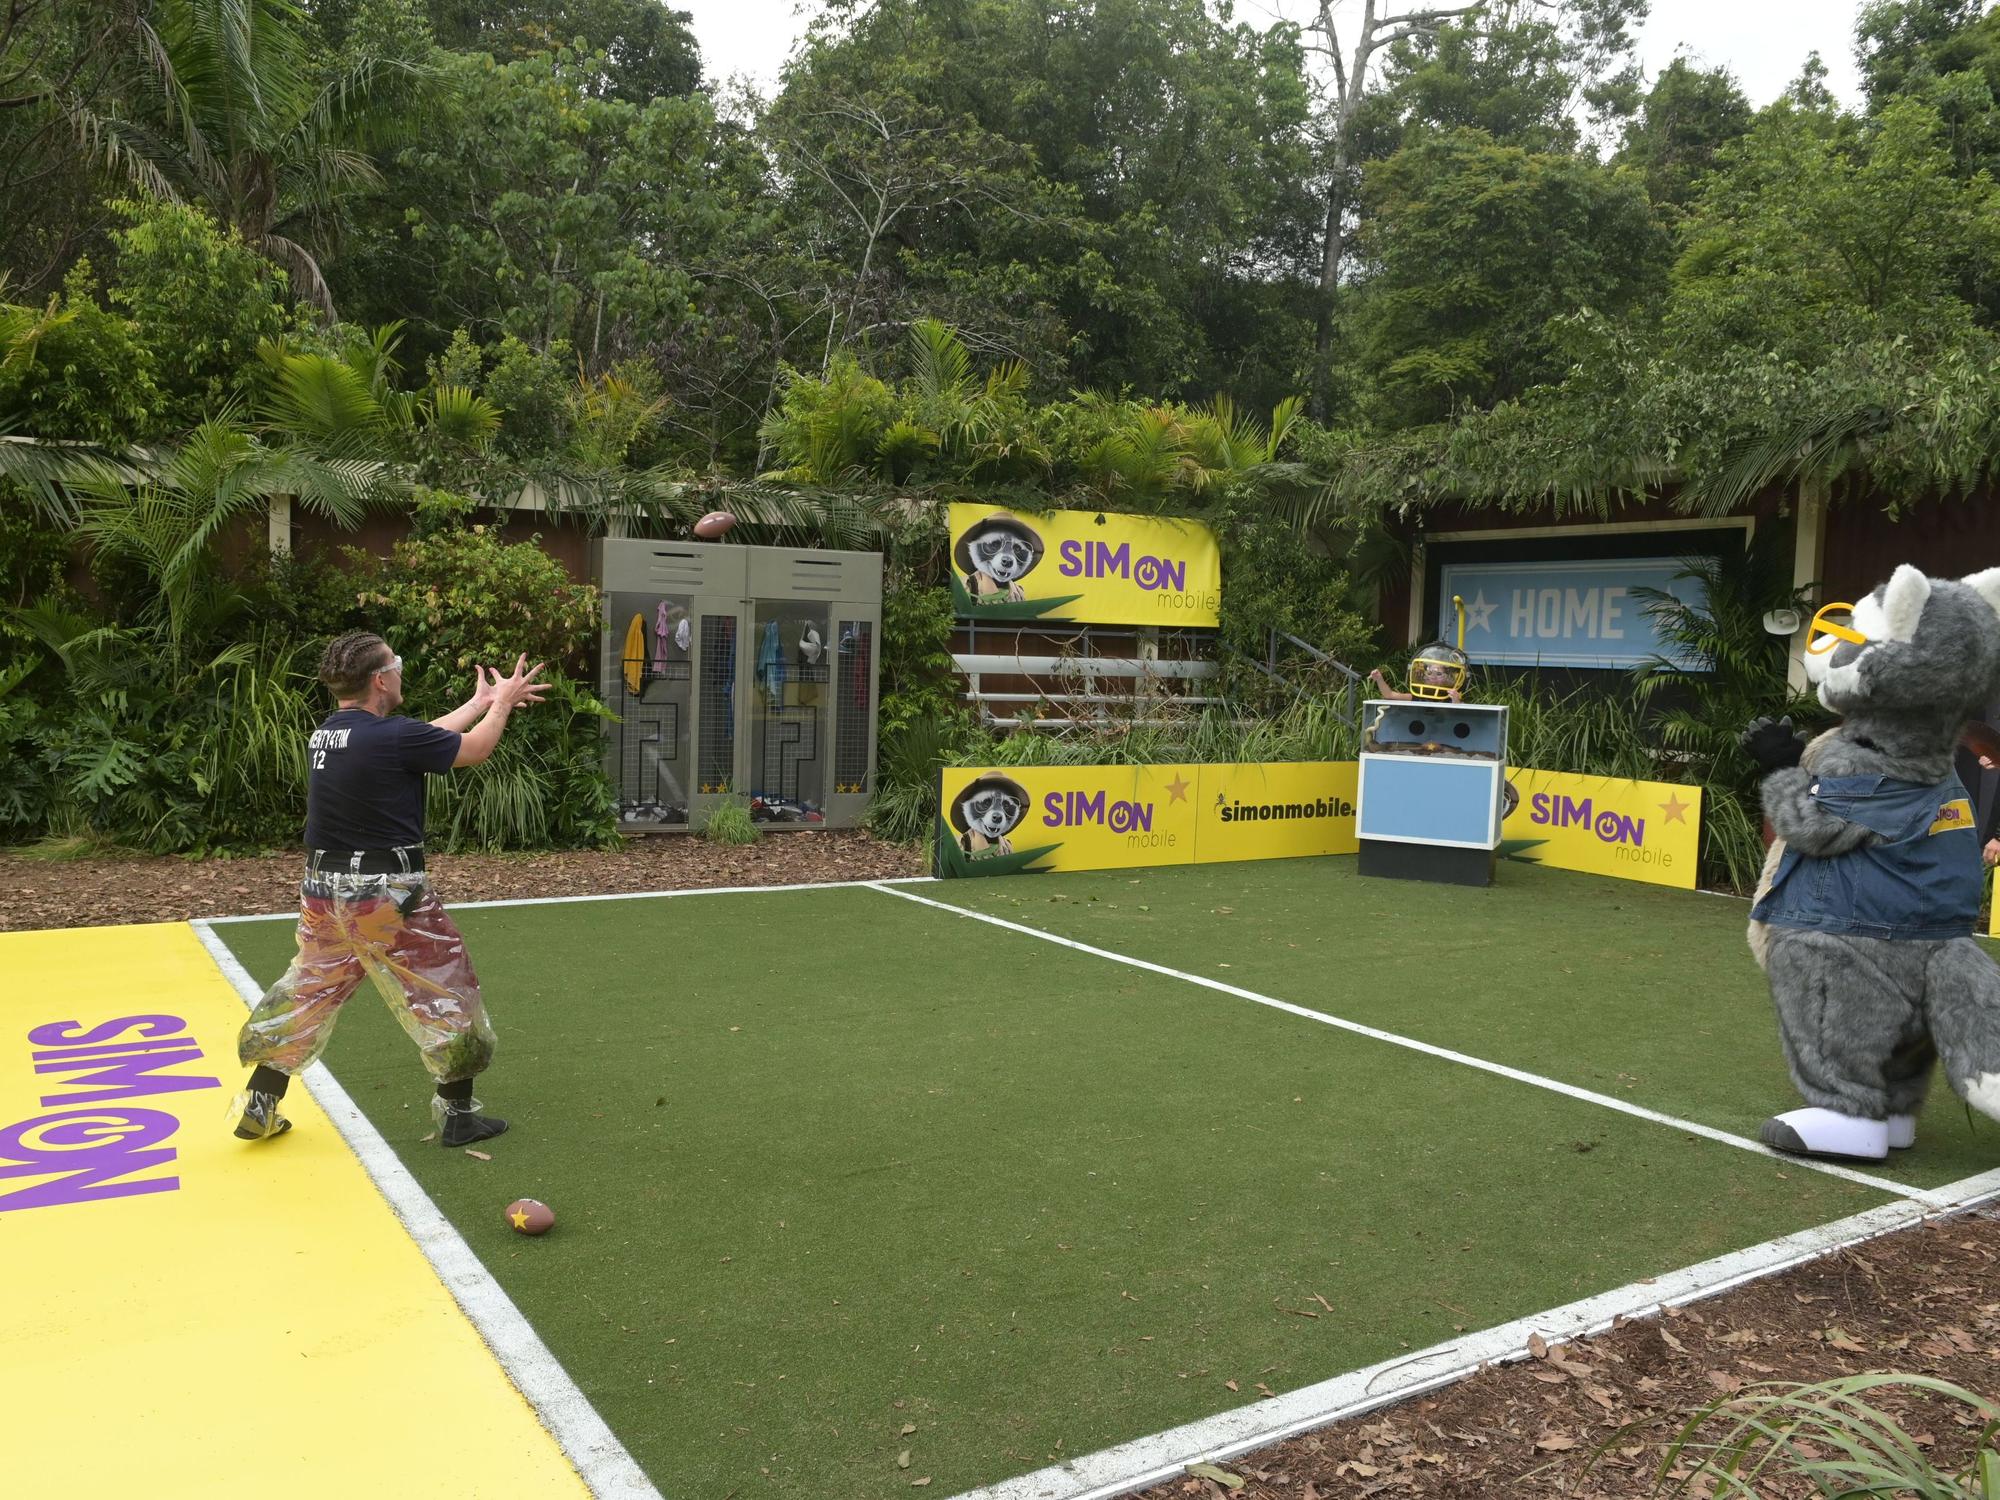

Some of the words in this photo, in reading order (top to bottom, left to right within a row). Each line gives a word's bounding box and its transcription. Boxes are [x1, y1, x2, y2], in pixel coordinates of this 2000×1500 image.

[1059, 540, 1186, 591] SIMON
[1157, 590, 1215, 609] mobile
[1510, 587, 1627, 639] HOME
[313, 750, 326, 769] 12
[1043, 790, 1154, 834] SIMON
[1530, 793, 1645, 846] SIMON
[1127, 829, 1176, 848] mobile
[1615, 845, 1672, 867] mobile
[0, 1014, 222, 1212] SIMON
